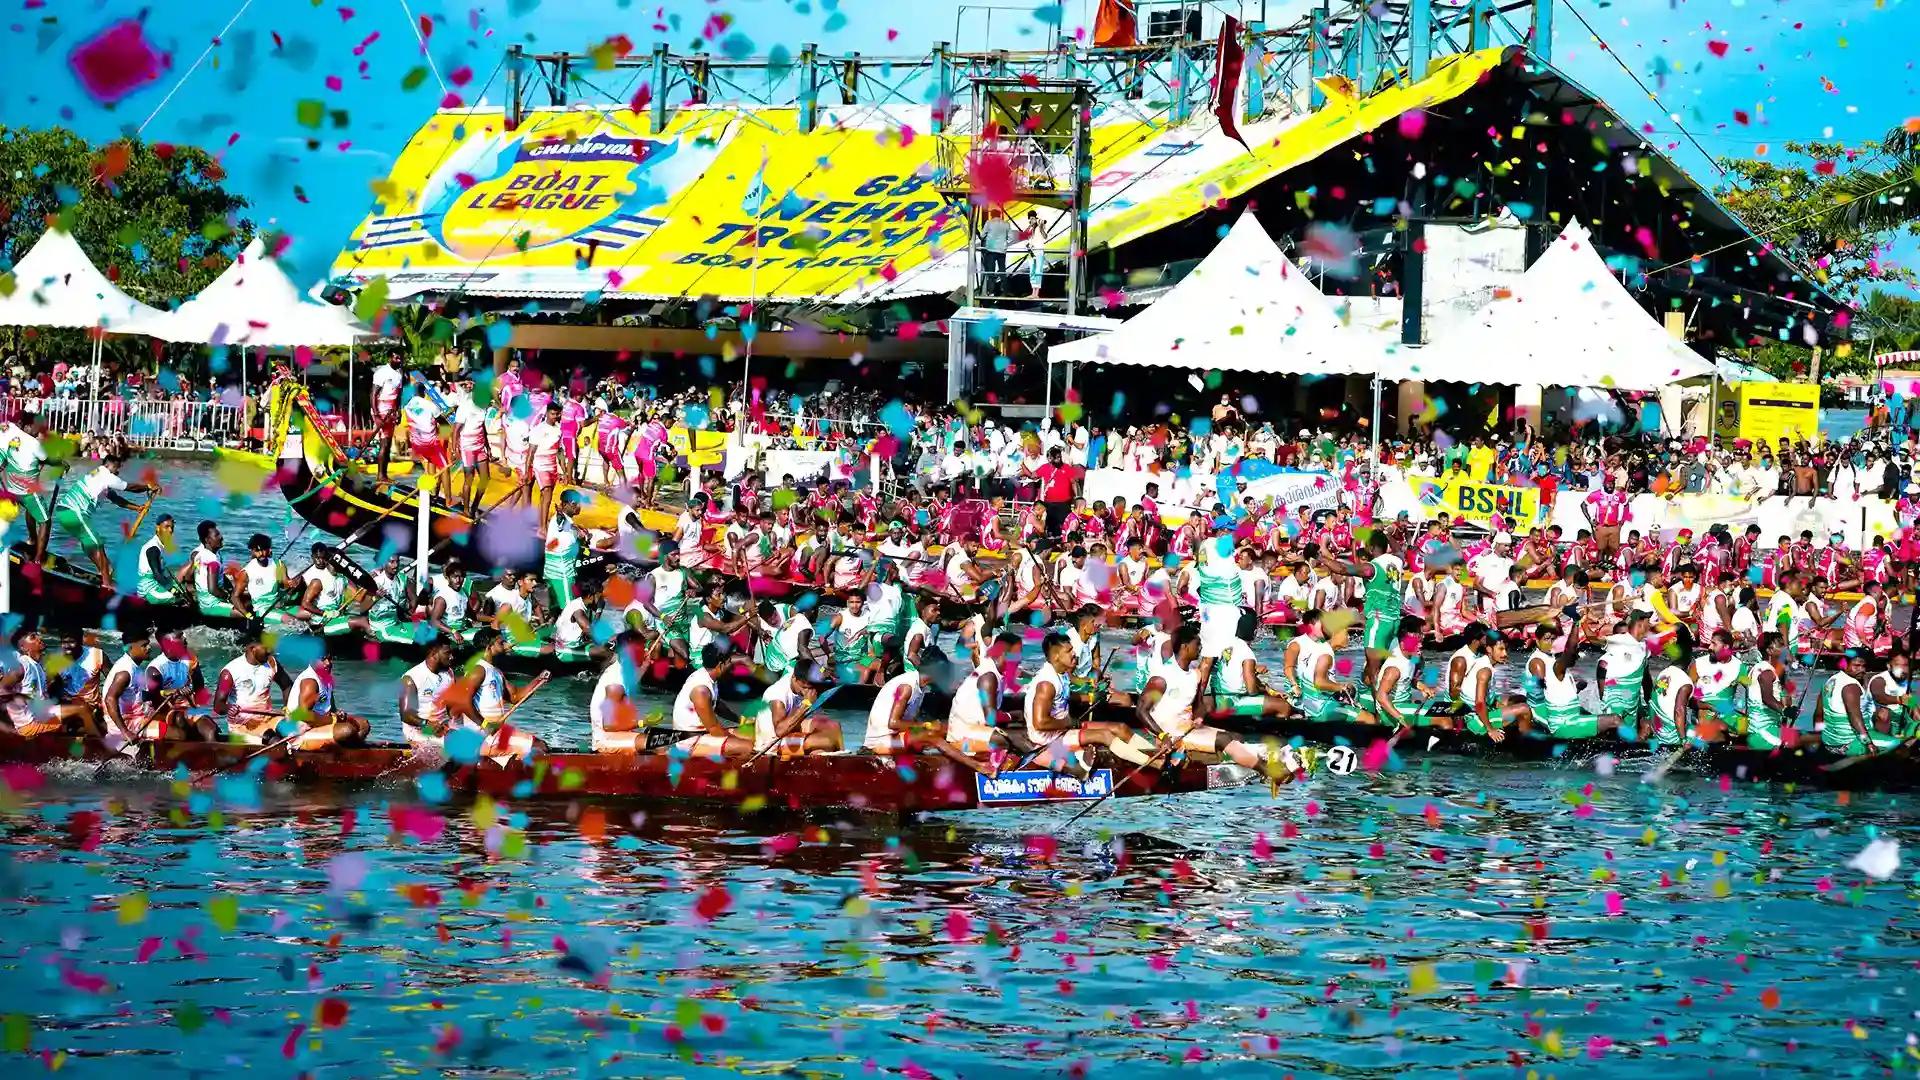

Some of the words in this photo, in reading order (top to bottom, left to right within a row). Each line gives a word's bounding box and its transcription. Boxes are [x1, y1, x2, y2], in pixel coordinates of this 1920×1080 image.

[506, 174, 610, 191] BOAT
[468, 192, 613, 210] LEAGUE
[672, 252, 785, 270] BOAT
[784, 254, 899, 269] RACE
[1459, 485, 1529, 518] BSNL
[1329, 749, 1355, 773] 21
